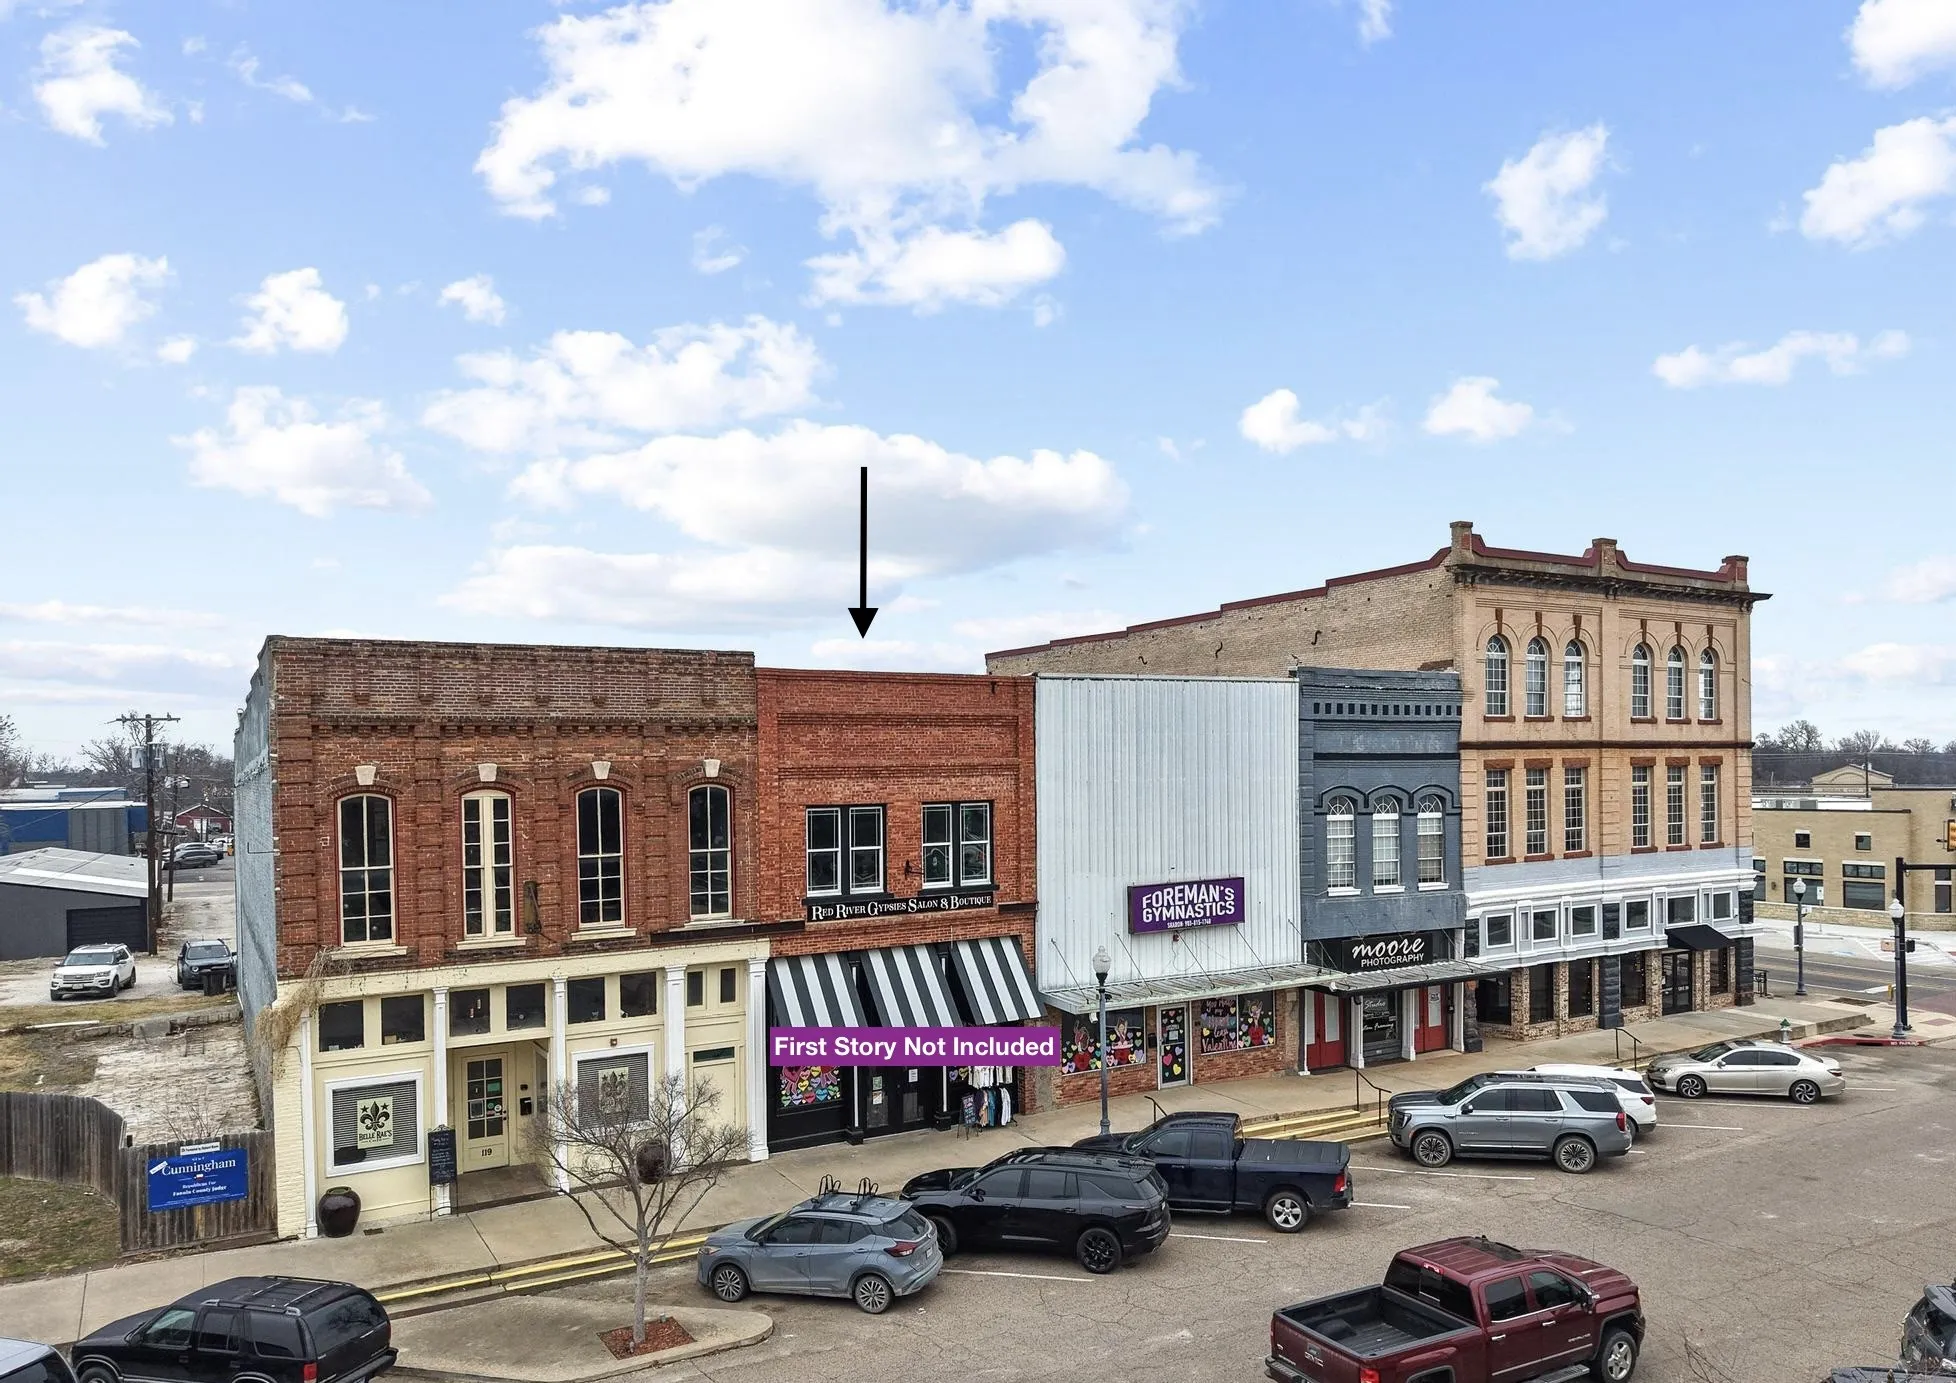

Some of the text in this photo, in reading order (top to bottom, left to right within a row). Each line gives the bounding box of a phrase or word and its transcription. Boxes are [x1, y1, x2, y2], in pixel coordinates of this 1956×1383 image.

[940, 898, 949, 910] &
[1142, 884, 1235, 909] FOREMAN'S
[1142, 900, 1235, 923] GYMNASTICS
[1351, 938, 1425, 960] moore
[1361, 953, 1425, 968] PHOTOGRAPHY
[481, 1147, 493, 1157] 119
[161, 1159, 236, 1176] Cunningham
